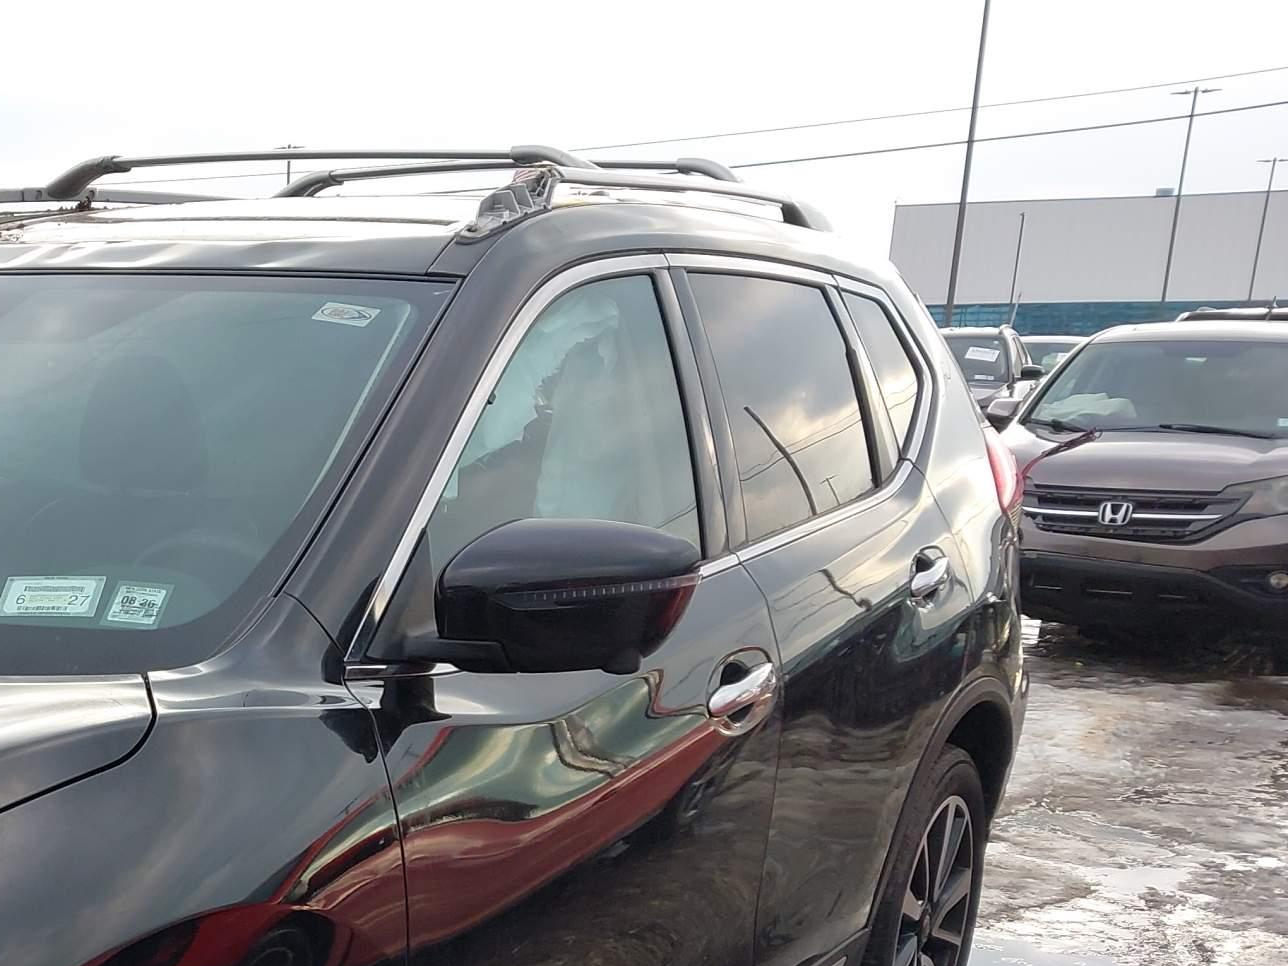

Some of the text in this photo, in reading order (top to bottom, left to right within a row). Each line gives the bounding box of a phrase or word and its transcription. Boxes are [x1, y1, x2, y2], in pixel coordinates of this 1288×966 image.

[15, 594, 27, 605] 6
[68, 594, 90, 607] 27
[121, 595, 137, 605] 08
